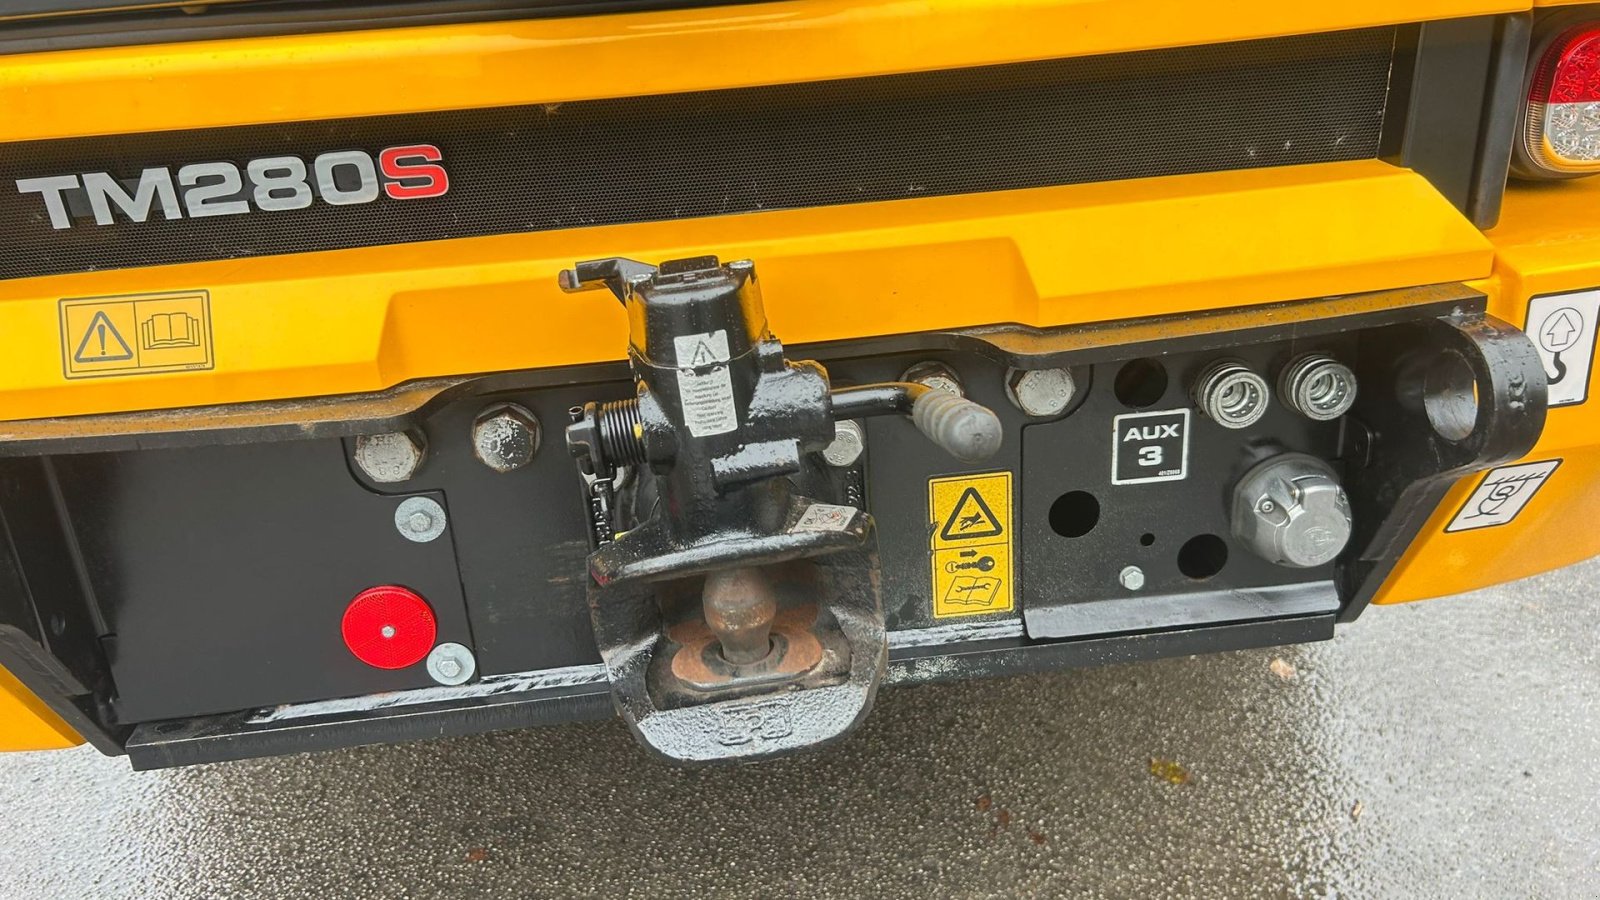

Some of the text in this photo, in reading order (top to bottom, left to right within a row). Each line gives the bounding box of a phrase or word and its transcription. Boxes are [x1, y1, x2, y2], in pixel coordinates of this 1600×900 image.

[15, 144, 449, 230] TM280S
[1123, 423, 1180, 442] AUX
[1138, 445, 1163, 467] 3
